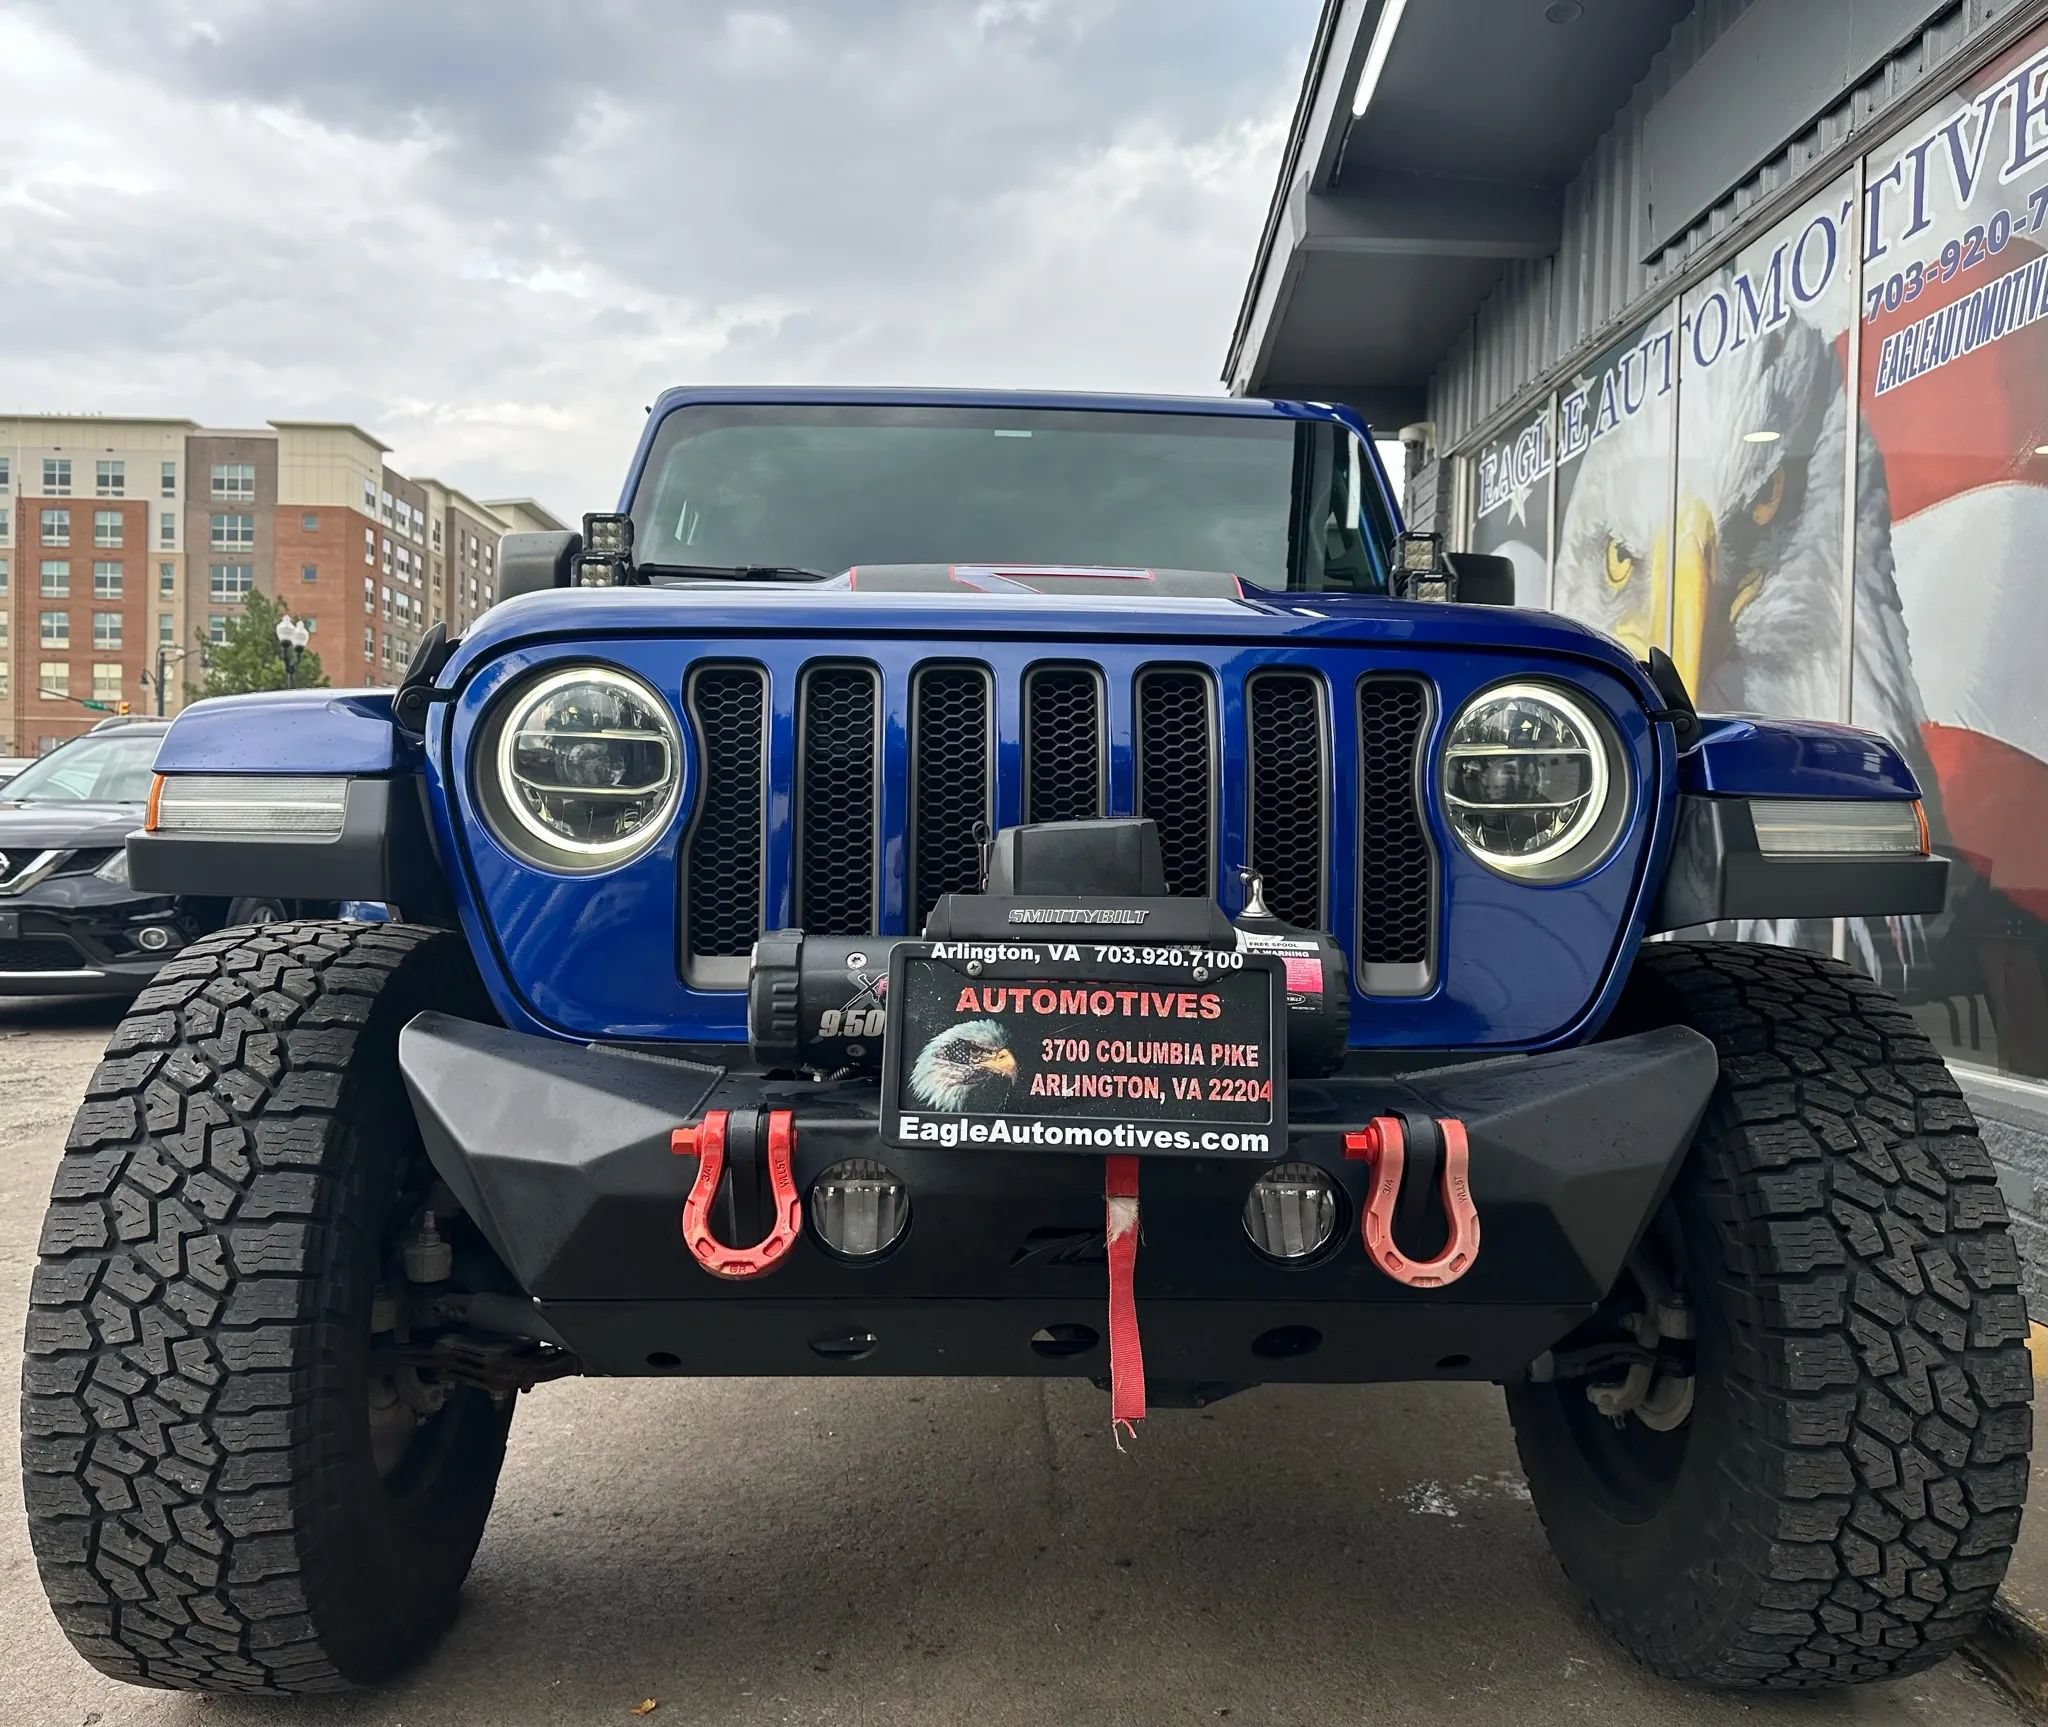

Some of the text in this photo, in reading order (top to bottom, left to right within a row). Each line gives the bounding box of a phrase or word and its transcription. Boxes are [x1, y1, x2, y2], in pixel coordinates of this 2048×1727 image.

[1866, 184, 2048, 323] 703-920-7
[1479, 389, 1589, 517] EAGLE
[1008, 909, 1150, 924] SMITTYBILT
[931, 942, 1243, 970] Arlington, VA 703.920.7100
[955, 986, 1221, 1020] AUTOMOTIVES
[1041, 1038, 1259, 1067] 3700 COLUMBIA PIKE
[1030, 1073, 1273, 1104] ARLINGTON, VA 22204
[899, 1116, 1269, 1153] EagleAutomotives.com
